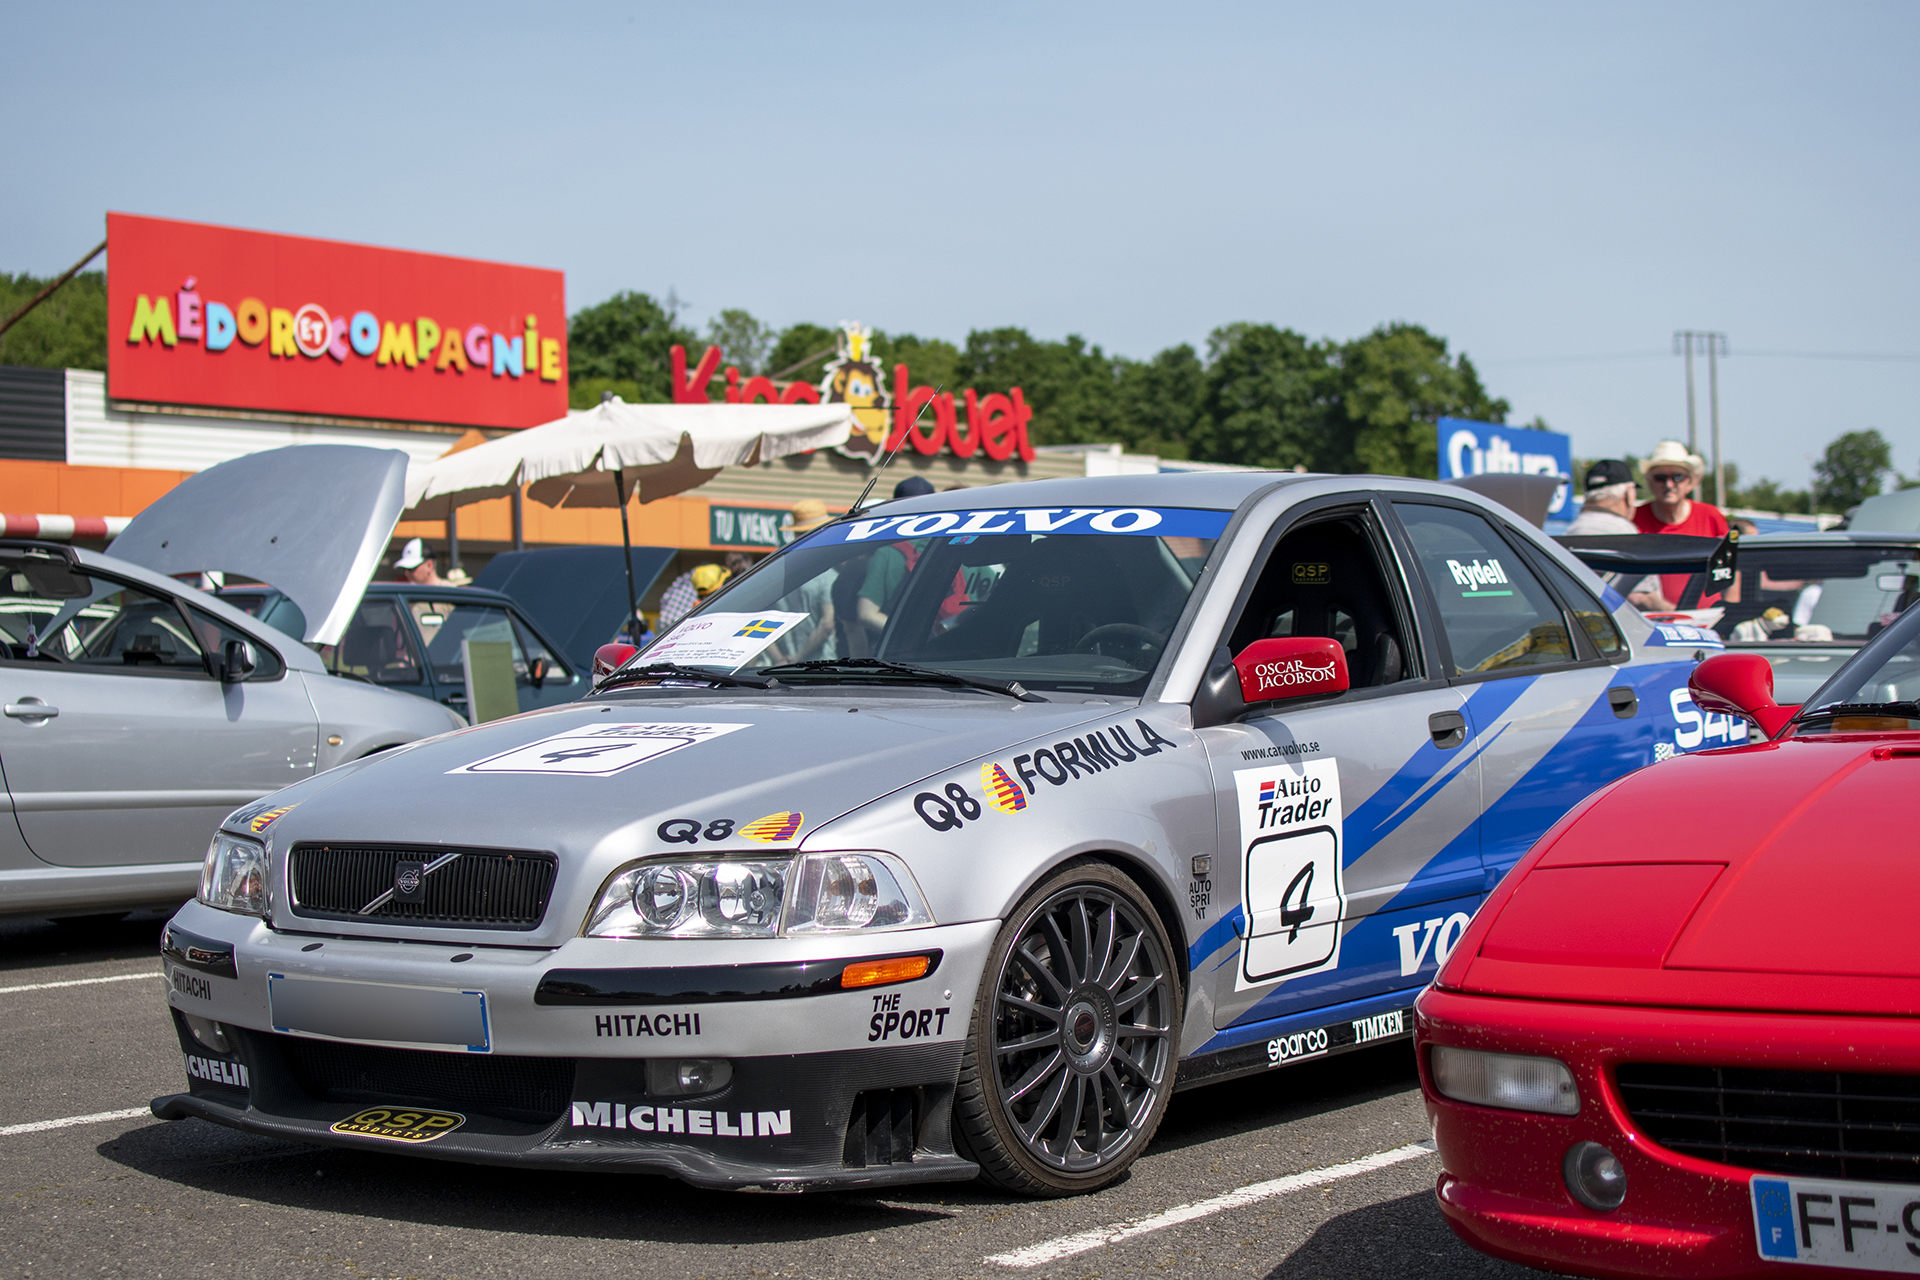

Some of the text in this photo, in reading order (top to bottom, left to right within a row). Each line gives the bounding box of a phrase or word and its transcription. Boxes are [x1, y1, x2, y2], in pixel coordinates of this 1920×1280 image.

[128, 277, 298, 357] MÉDOR
[299, 315, 326, 345] ET
[885, 364, 1036, 463] Jouet
[714, 509, 734, 541] TU
[845, 509, 1163, 541] VOLVO
[1294, 565, 1329, 577] QSP
[1445, 559, 1508, 591] Rydell
[1255, 659, 1303, 677] OSCAR
[1258, 667, 1336, 692] JACOBSON
[540, 742, 637, 764] 4
[1240, 740, 1320, 761] www.car.volvo.se
[914, 718, 1177, 832] Q8 FORMULA
[1275, 775, 1321, 799] Auto
[1258, 795, 1333, 829] Trader
[657, 818, 735, 844] Q8
[399, 878, 420, 887] VOLVO
[1189, 880, 1212, 895] AUTO
[1190, 893, 1210, 908] SPRI
[1195, 907, 1206, 920] NT
[1280, 861, 1315, 945] 4
[1392, 912, 1470, 977] VO
[173, 970, 212, 1000] HITACHI
[872, 993, 902, 1012] THE
[595, 1013, 701, 1037] HITACHI
[868, 1007, 951, 1042] SPORT
[1352, 1010, 1404, 1044] TIMKEN
[1267, 1028, 1328, 1067] sparco
[354, 1110, 455, 1131] QSP
[571, 1101, 792, 1137] MICHELIN
[1771, 1227, 1782, 1244] F
